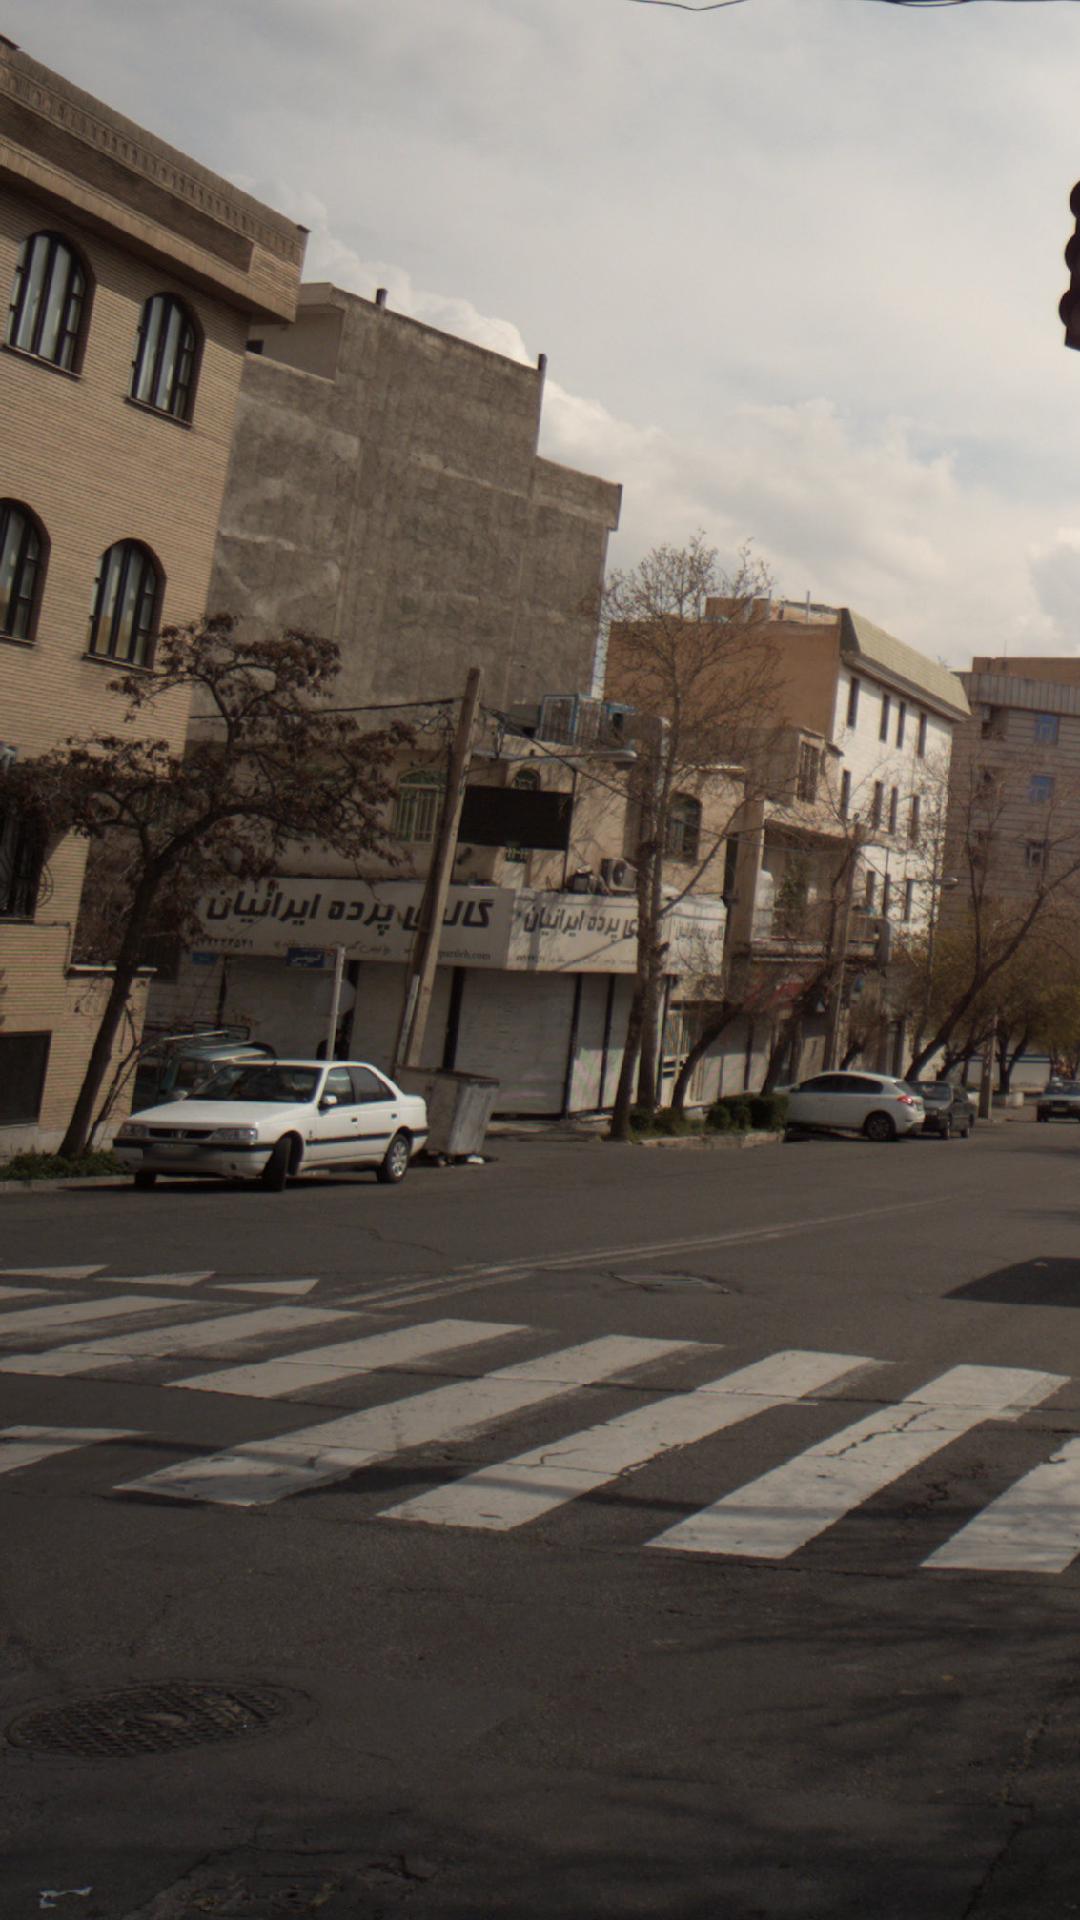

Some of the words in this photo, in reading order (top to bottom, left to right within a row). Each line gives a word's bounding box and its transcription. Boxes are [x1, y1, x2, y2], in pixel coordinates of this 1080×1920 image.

[206, 889, 322, 926] ایرانیان
[328, 900, 396, 936] پرده
[523, 905, 586, 937] ایرانیان
